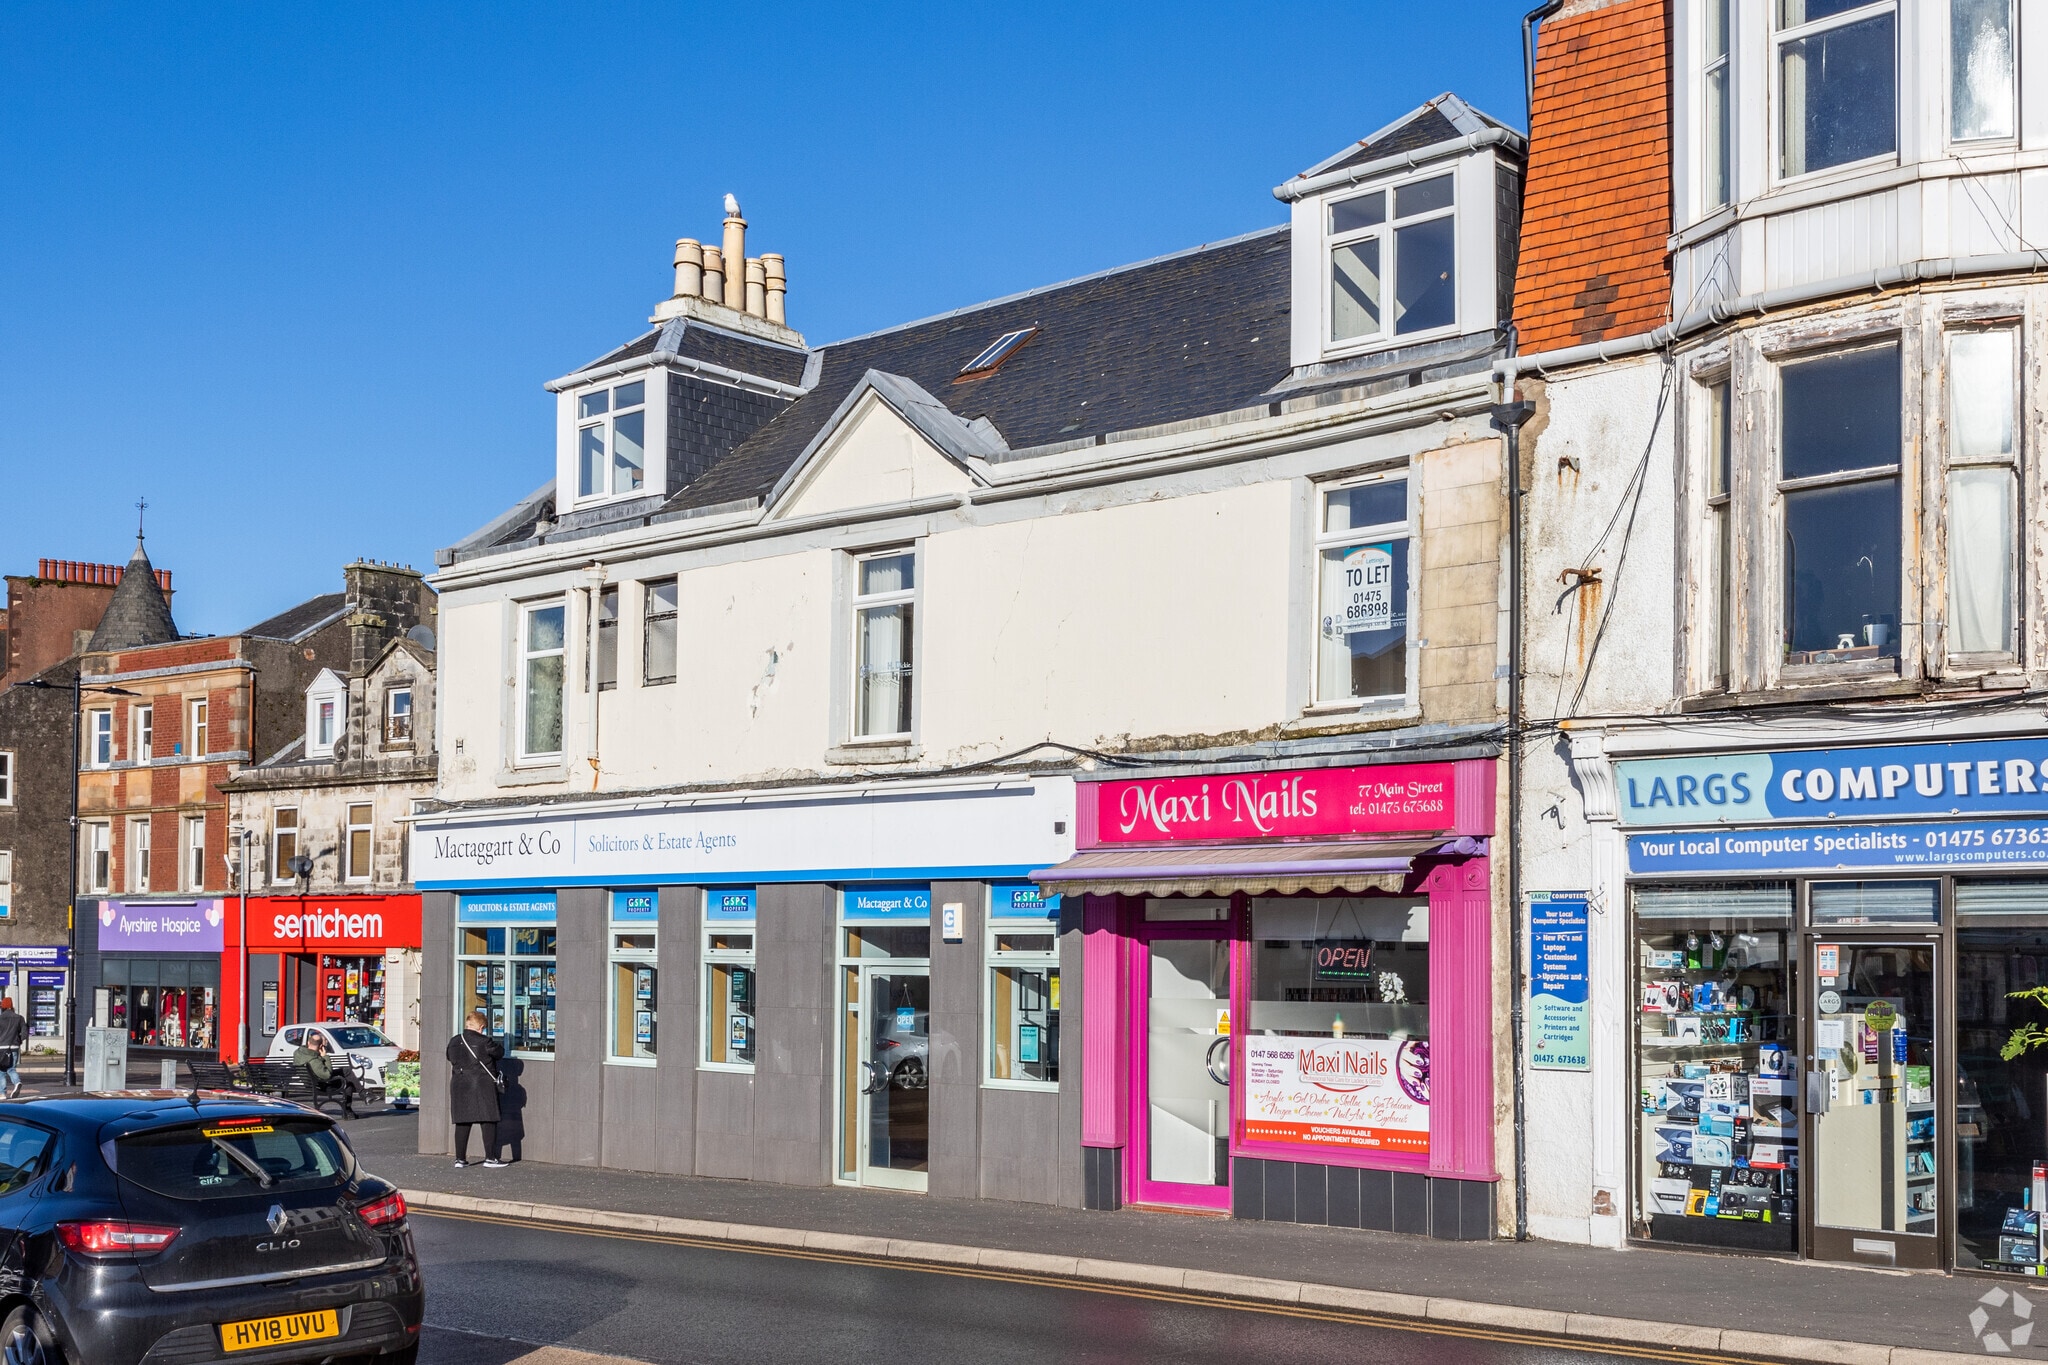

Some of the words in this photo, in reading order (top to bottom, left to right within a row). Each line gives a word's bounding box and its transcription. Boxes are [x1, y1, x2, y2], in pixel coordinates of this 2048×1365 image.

[1346, 568, 1362, 587] TO
[1367, 565, 1390, 585] LET
[1354, 590, 1382, 604] 01475
[1346, 602, 1388, 619] 686898
[1358, 785, 1373, 798] 77
[1374, 782, 1404, 799] Main
[1407, 781, 1444, 795] Street
[1628, 771, 1751, 808] LARGS
[1120, 783, 1211, 834] Maxi
[1222, 776, 1318, 833] Nails
[1350, 802, 1366, 816] tel:
[1368, 801, 1400, 815] 01475
[1402, 800, 1444, 814] 675688
[434, 835, 513, 866] Mactaggart
[518, 832, 533, 856] &
[539, 830, 561, 855] Co
[588, 833, 639, 853] Solicitors
[642, 833, 654, 850] &
[658, 831, 693, 850] Estate
[695, 830, 736, 855] Agents
[1640, 841, 1675, 858] Your
[1679, 838, 1720, 856] Local
[1725, 835, 1809, 857] Computer
[1814, 832, 1908, 854] Specialists
[1926, 830, 1985, 848] 01475
[628, 898, 650, 906] GSPC
[724, 896, 747, 906] GSPC
[1531, 892, 1549, 900] LARGS
[1551, 892, 1588, 900] COMPUTERS
[468, 904, 502, 912] SOLICITORS
[504, 904, 508, 912] &
[510, 903, 530, 912] ESTATE
[531, 902, 556, 911] AGENTS
[858, 897, 901, 912] Mactaggart
[904, 898, 912, 908] &
[914, 896, 928, 908] Co
[120, 915, 158, 936] Ayrshire
[162, 917, 200, 936] Hospice
[274, 908, 382, 938] semichem
[1543, 934, 1556, 942] New
[1558, 934, 1570, 942] PC's
[1572, 934, 1582, 942] and
[1543, 944, 1566, 952] Laptops
[1317, 947, 1371, 968] OPEN
[1542, 973, 1570, 981] Upgrades
[1570, 972, 1582, 980] and
[1543, 982, 1564, 990] Repairs
[1544, 1004, 1571, 1012] Software
[896, 1015, 914, 1025] OPEN
[1544, 1014, 1576, 1022] Accessories
[1251, 1050, 1266, 1058] 0147
[1266, 1051, 1278, 1059] 568
[1279, 1052, 1294, 1060] 6265
[1558, 1056, 1586, 1064] 673638
[1299, 1049, 1340, 1074] Maxi
[1346, 1050, 1388, 1076] Nails
[1311, 1126, 1340, 1136] VOUCHERS
[1342, 1128, 1372, 1137] AVAILABLE
[1312, 1134, 1350, 1144] APPOINTMENT
[1351, 1136, 1380, 1146] REQUIRED
[256, 1240, 300, 1252] CLIO
[236, 1320, 282, 1344] HY18
[286, 1314, 326, 1336] UVU
